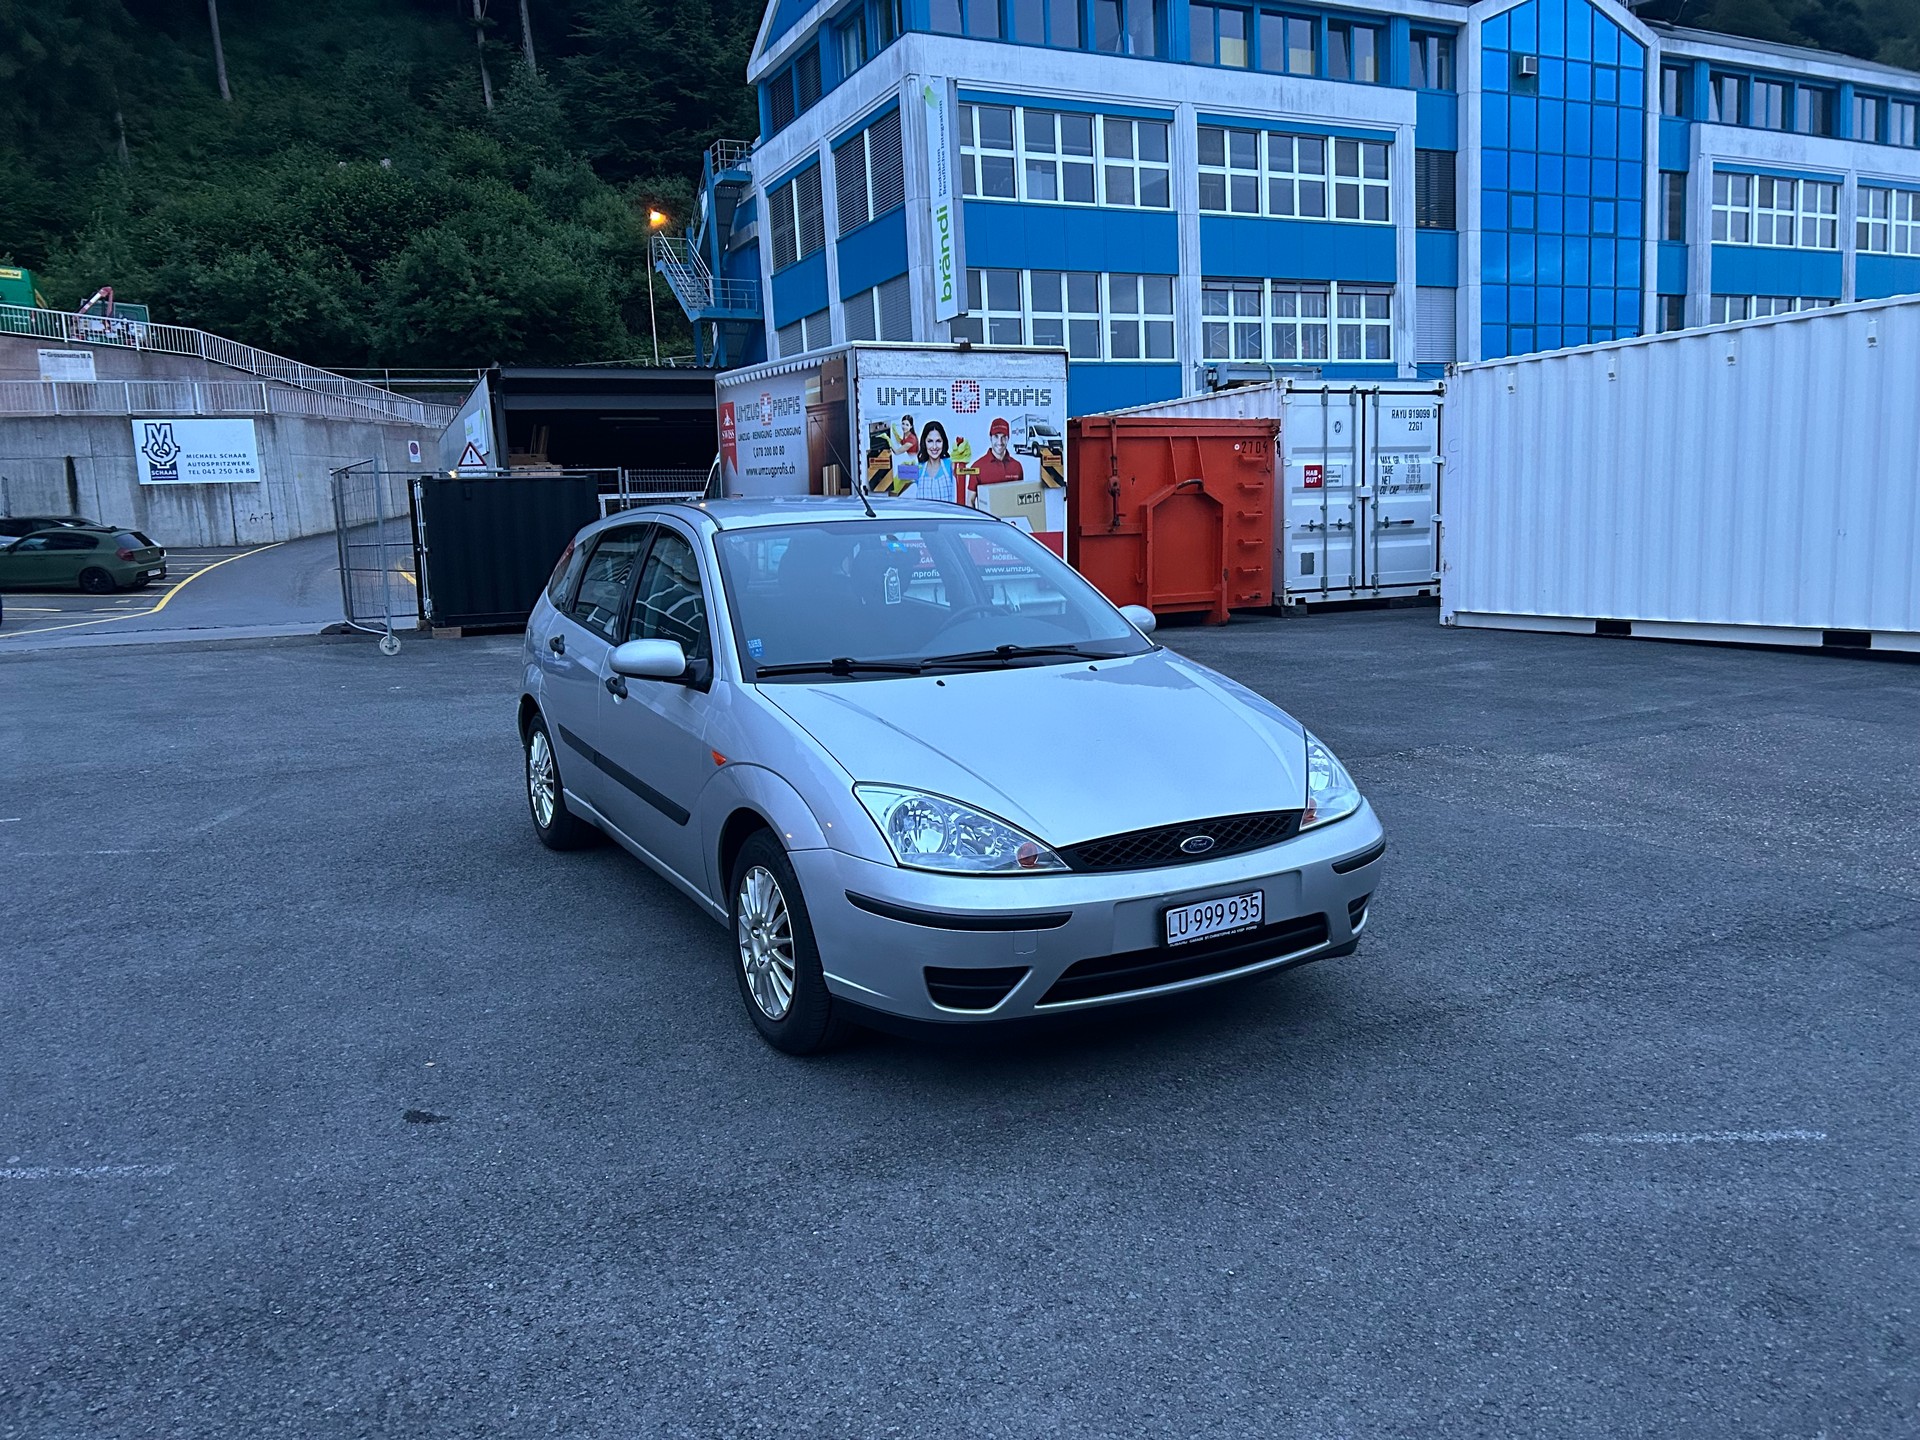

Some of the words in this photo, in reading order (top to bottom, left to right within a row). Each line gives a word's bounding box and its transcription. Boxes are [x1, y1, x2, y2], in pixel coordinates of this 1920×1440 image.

[936, 204, 952, 303] brändi
[876, 387, 947, 406] UMZUG
[984, 387, 1052, 407] PROFIS
[736, 402, 760, 423] UMZUG
[772, 395, 801, 418] PROFIS
[1391, 409, 1407, 419] RAYU
[1408, 408, 1431, 419] 919099
[1408, 421, 1423, 431] 22G1
[721, 429, 735, 441] SWISS
[738, 432, 750, 442] UMZUG
[752, 429, 773, 440] REINIGUNG
[774, 426, 802, 438] ENTSORGUNG
[1241, 440, 1268, 454] 2704
[745, 462, 796, 478] www.umzugprofis.ch
[1305, 469, 1318, 477] HAB
[1305, 476, 1318, 484] GUT
[1381, 475, 1391, 485] NET
[1228, 895, 1260, 923] 935
